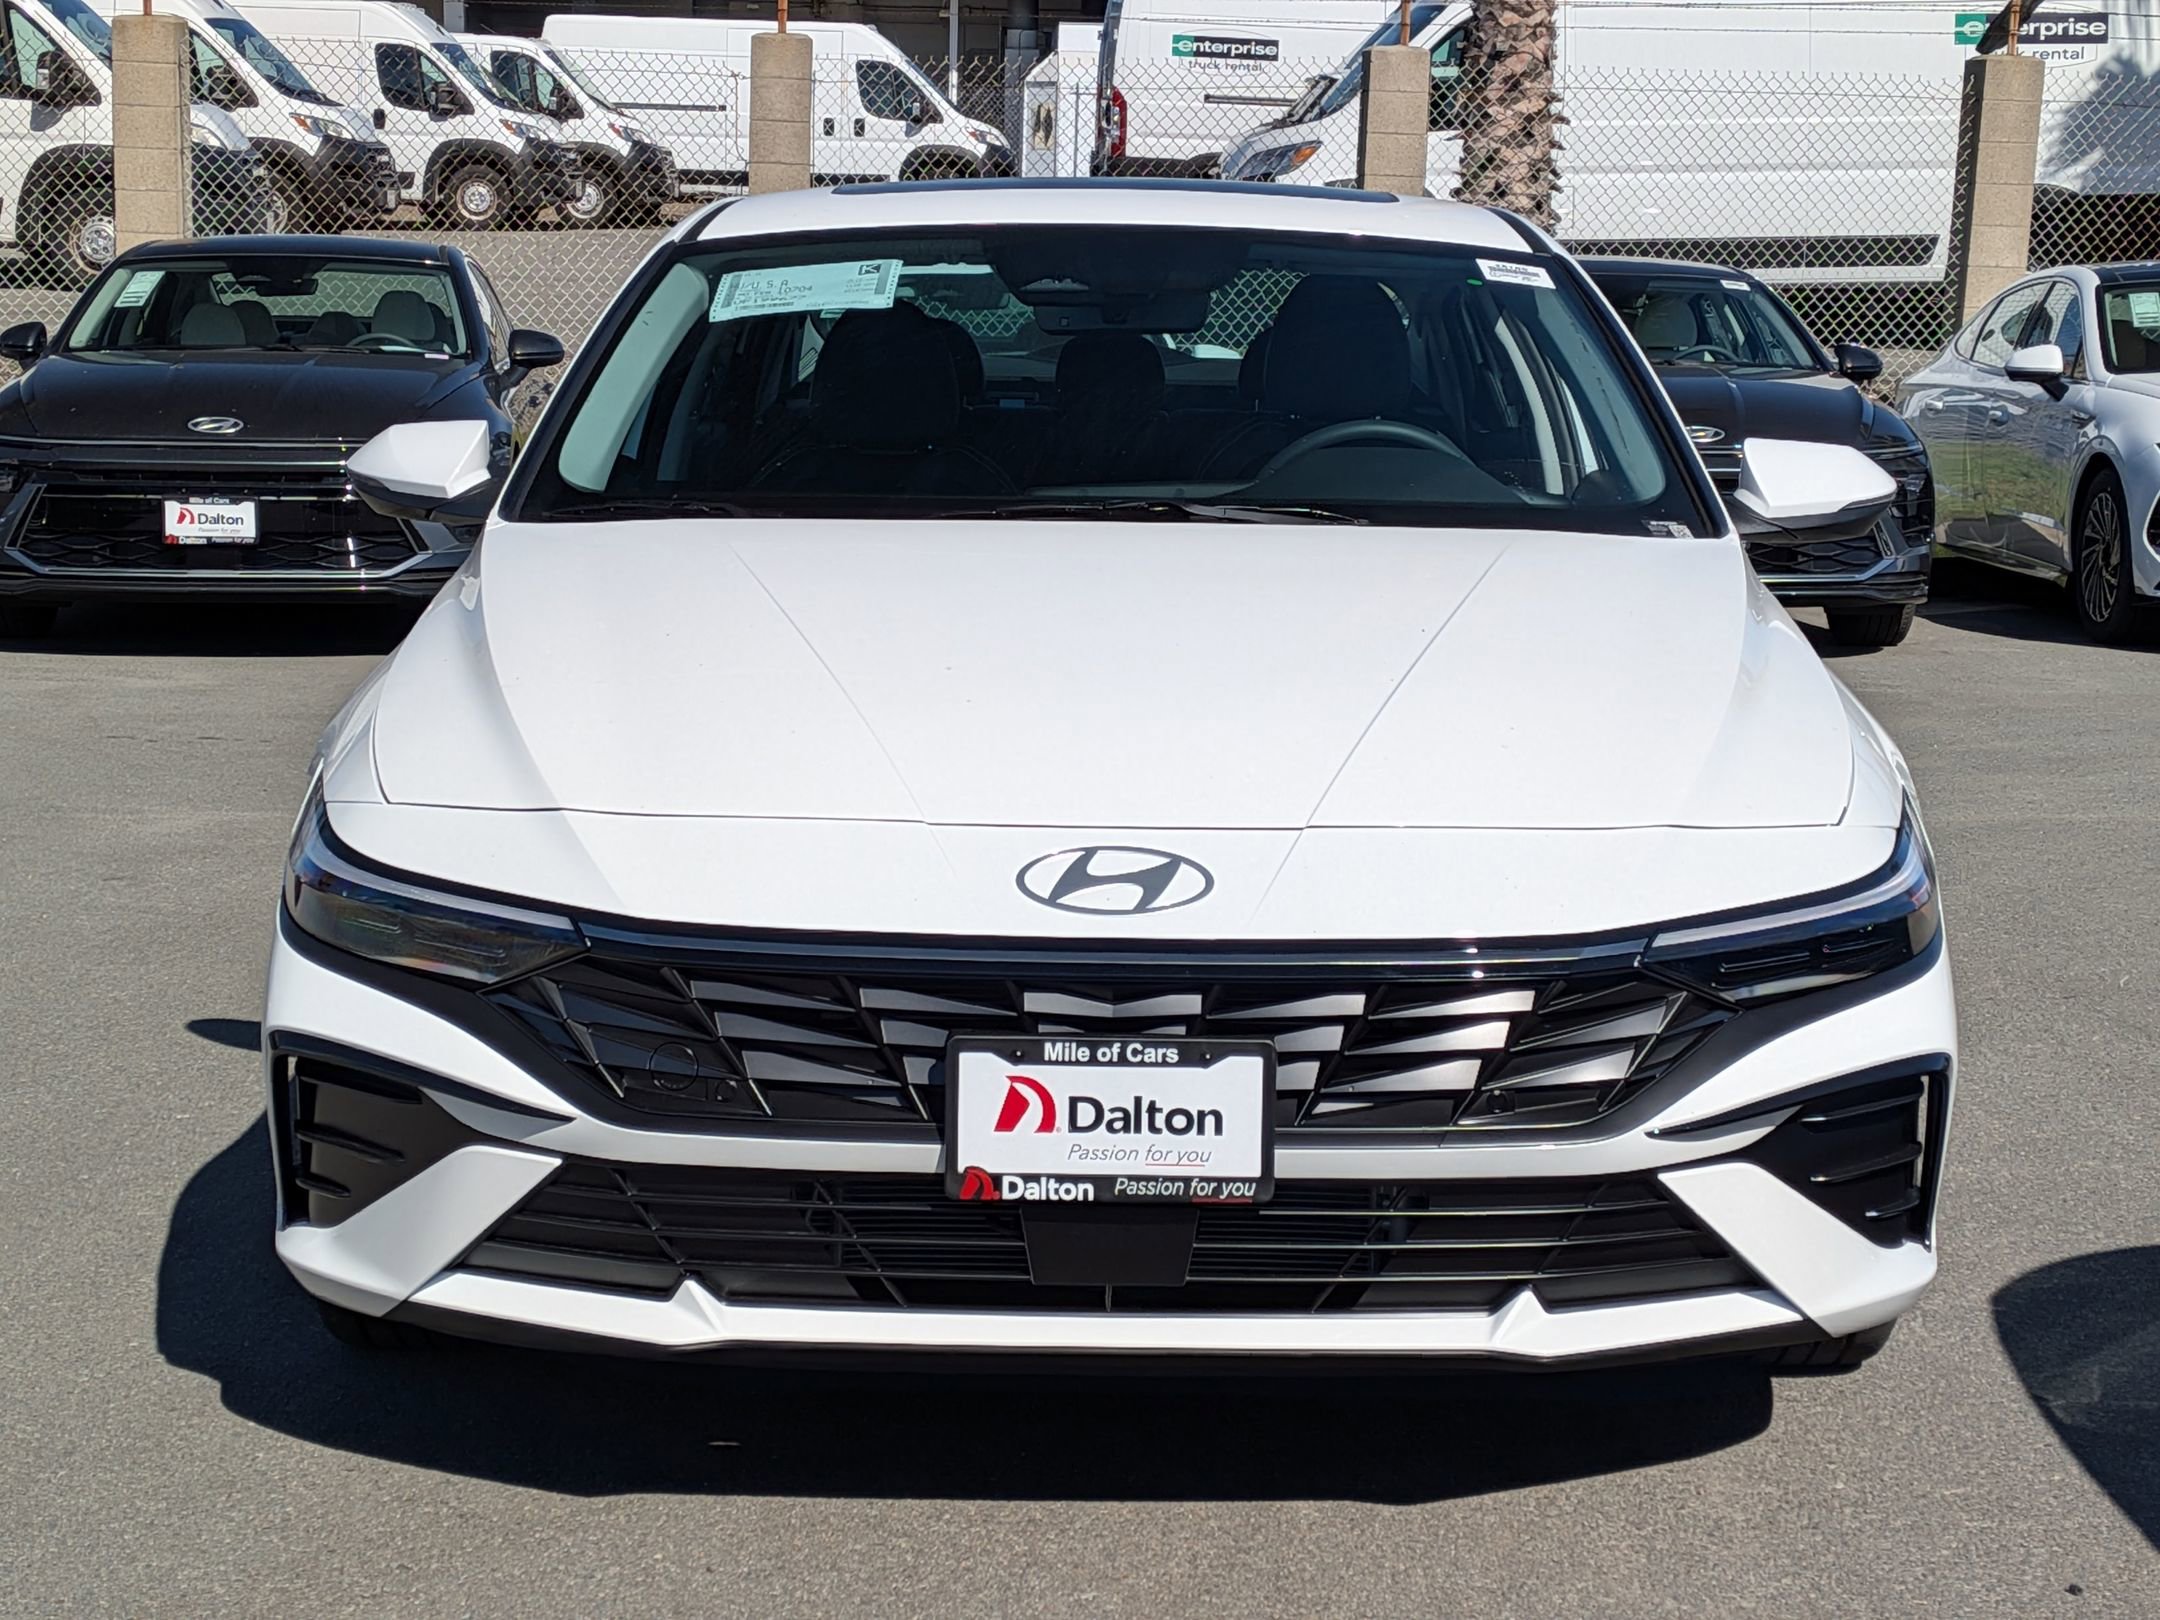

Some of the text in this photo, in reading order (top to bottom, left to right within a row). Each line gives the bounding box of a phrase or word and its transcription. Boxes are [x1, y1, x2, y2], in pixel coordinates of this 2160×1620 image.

[1962, 18, 2107, 40] eerprise
[1177, 40, 1278, 57] enterprise
[2033, 46, 2085, 60] rental
[197, 513, 244, 526] Dalton
[1044, 1042, 1180, 1064] Mile of Cars
[1067, 1095, 1223, 1137] Dalton
[1067, 1143, 1212, 1165] Passion for you
[1001, 1175, 1095, 1201] Dalton
[1114, 1177, 1256, 1199] Passion for you
